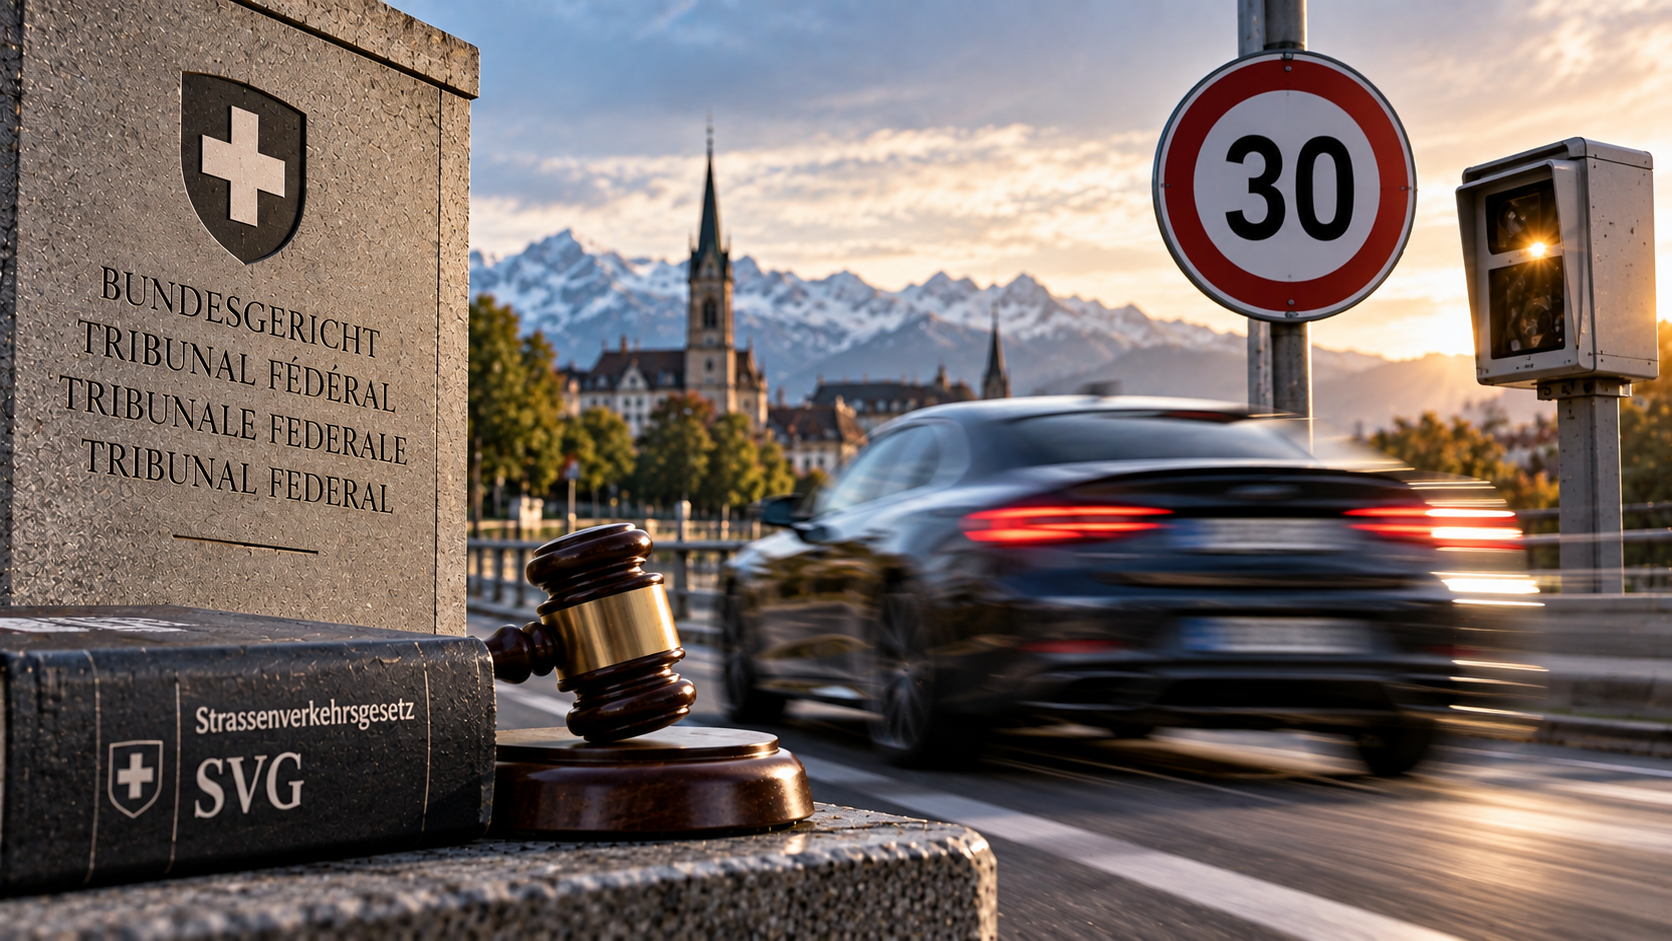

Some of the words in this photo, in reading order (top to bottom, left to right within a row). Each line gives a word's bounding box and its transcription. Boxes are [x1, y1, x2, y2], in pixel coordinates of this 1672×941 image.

[1225, 134, 1354, 241] 30
[101, 266, 380, 358] BUNDESGERICHT
[77, 319, 256, 386] TRIBUNAL
[268, 356, 396, 413] FÉDÉRAL
[58, 375, 257, 441] TRIBUNALE
[269, 414, 408, 465] FEDERALE
[82, 438, 257, 496] TRIBUNAL
[269, 467, 394, 514] FEDERAL
[195, 698, 415, 734] Strassenverkehrsgesetz
[194, 752, 304, 818] SVG
